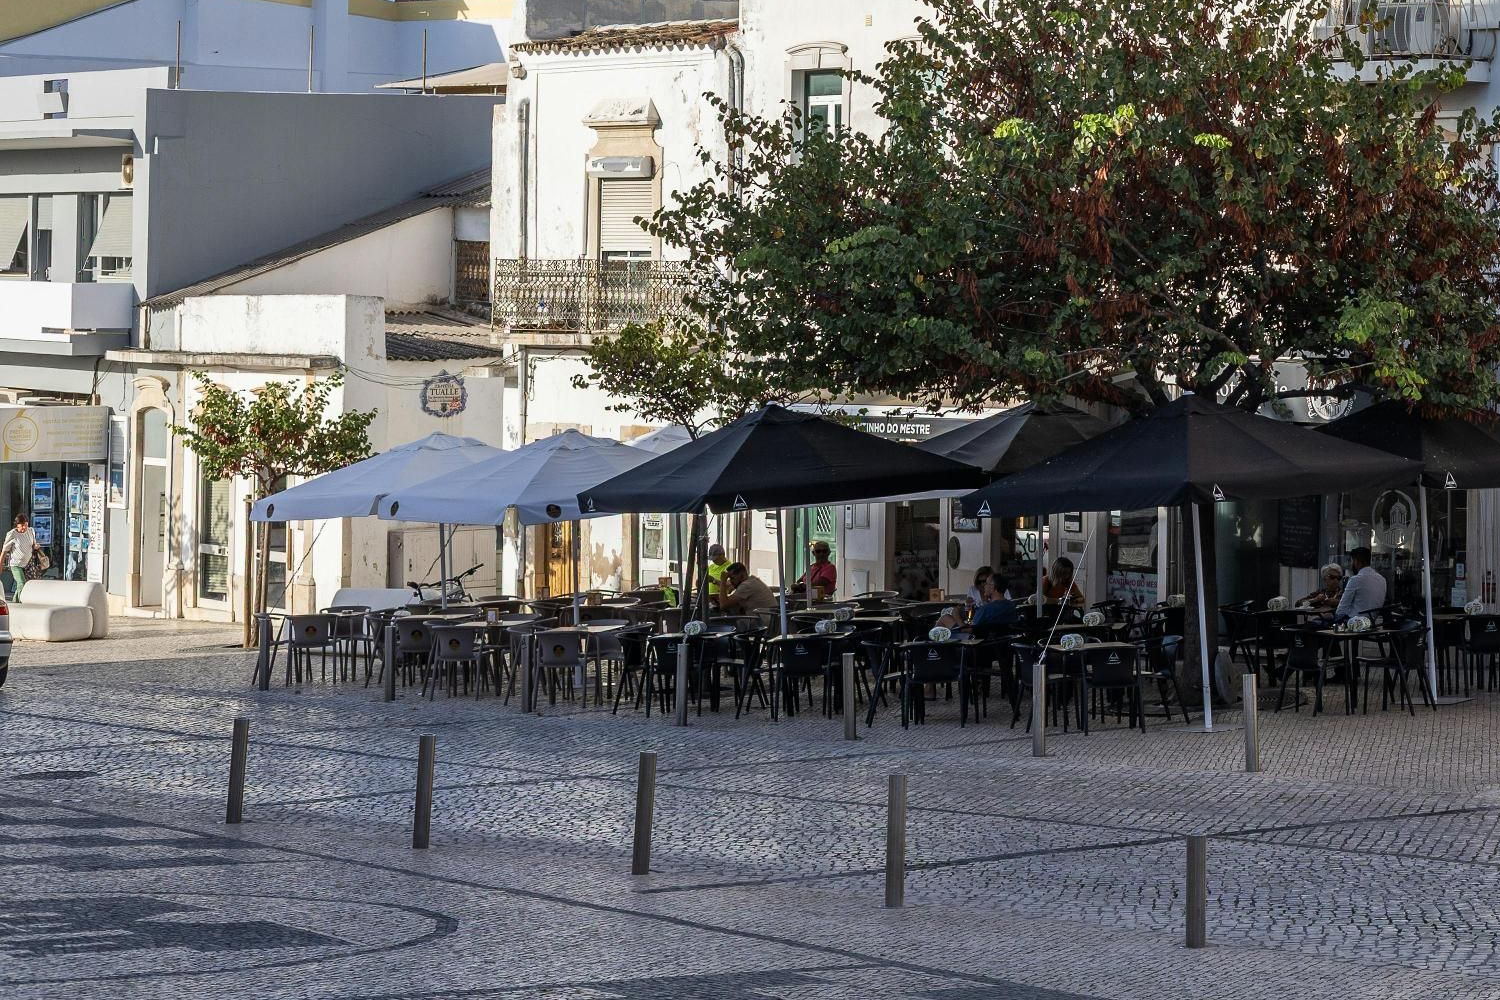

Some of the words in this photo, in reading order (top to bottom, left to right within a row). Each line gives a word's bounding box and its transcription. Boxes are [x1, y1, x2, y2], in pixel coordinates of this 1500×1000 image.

[430, 388, 459, 396] TUALLE
[887, 423, 898, 434] DO
[899, 424, 931, 435] MESTRE
